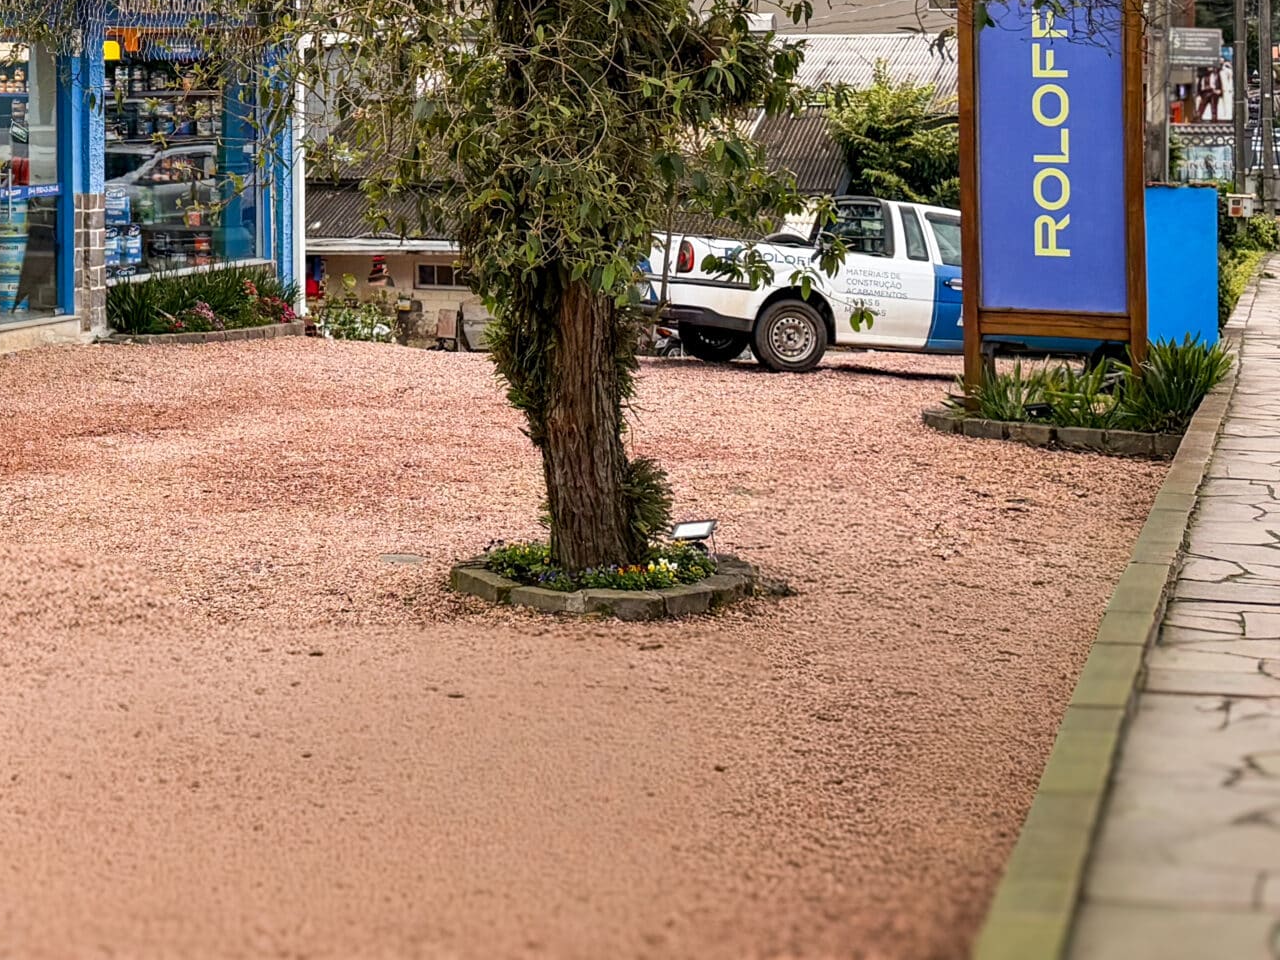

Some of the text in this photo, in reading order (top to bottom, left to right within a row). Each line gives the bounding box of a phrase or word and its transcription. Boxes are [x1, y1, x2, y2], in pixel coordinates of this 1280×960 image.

[1031, 6, 1071, 257] ROLOFF
[846, 268, 889, 279] MATERIAIS
[846, 287, 908, 299] ACABAMENTOS
